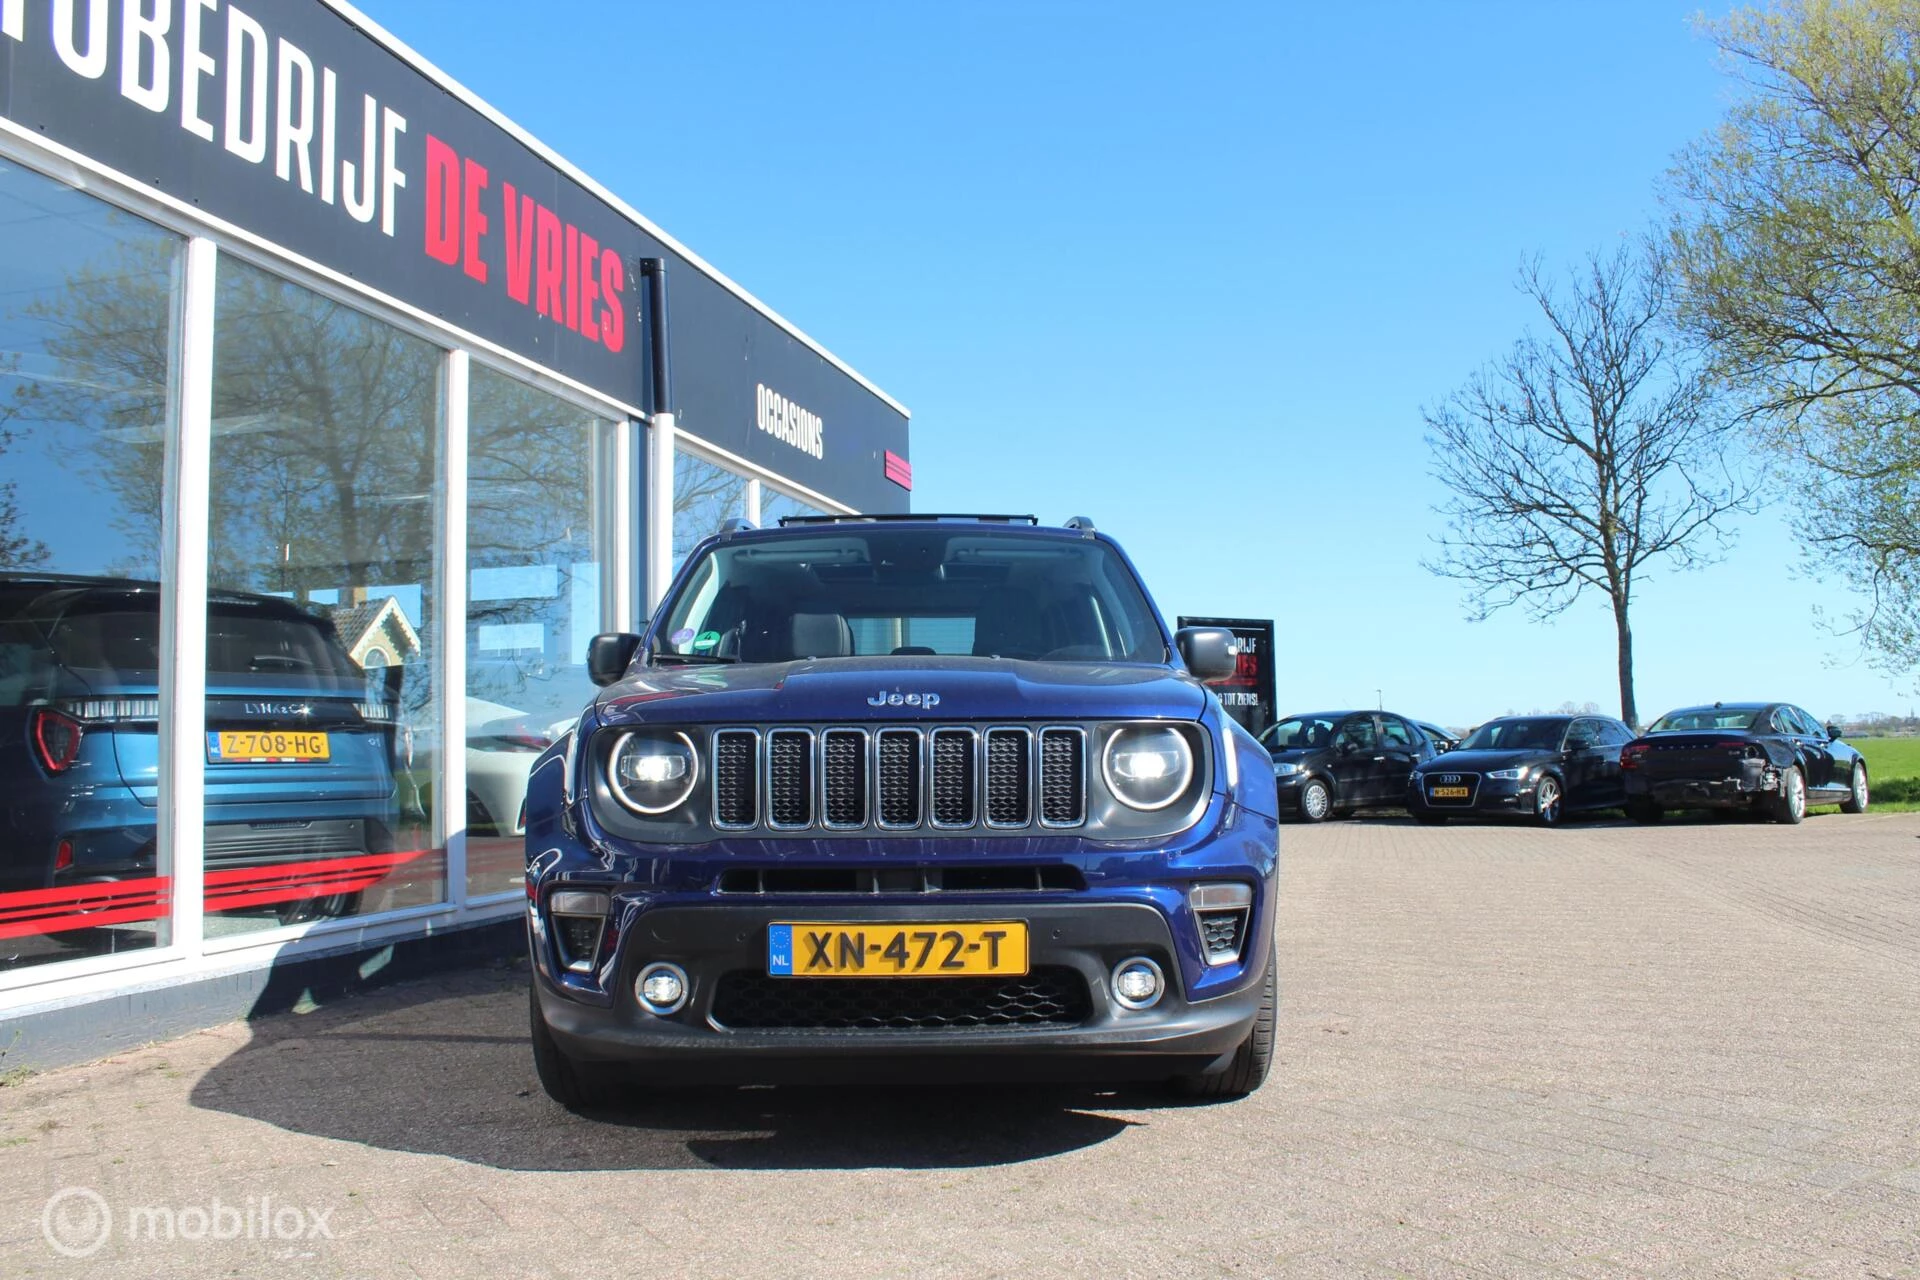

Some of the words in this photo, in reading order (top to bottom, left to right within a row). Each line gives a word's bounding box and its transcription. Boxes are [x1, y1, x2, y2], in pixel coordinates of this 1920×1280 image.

[0, 0, 407, 237] BEDRIJF
[424, 132, 488, 284] DE
[503, 181, 625, 353] VRIES
[756, 383, 823, 460] OCCASIONS
[867, 690, 940, 710] Jeep
[1223, 692, 1236, 706] TOT
[226, 735, 323, 754] Z-708-HG
[772, 954, 789, 967] NL
[806, 930, 1007, 970] XN-472-T
